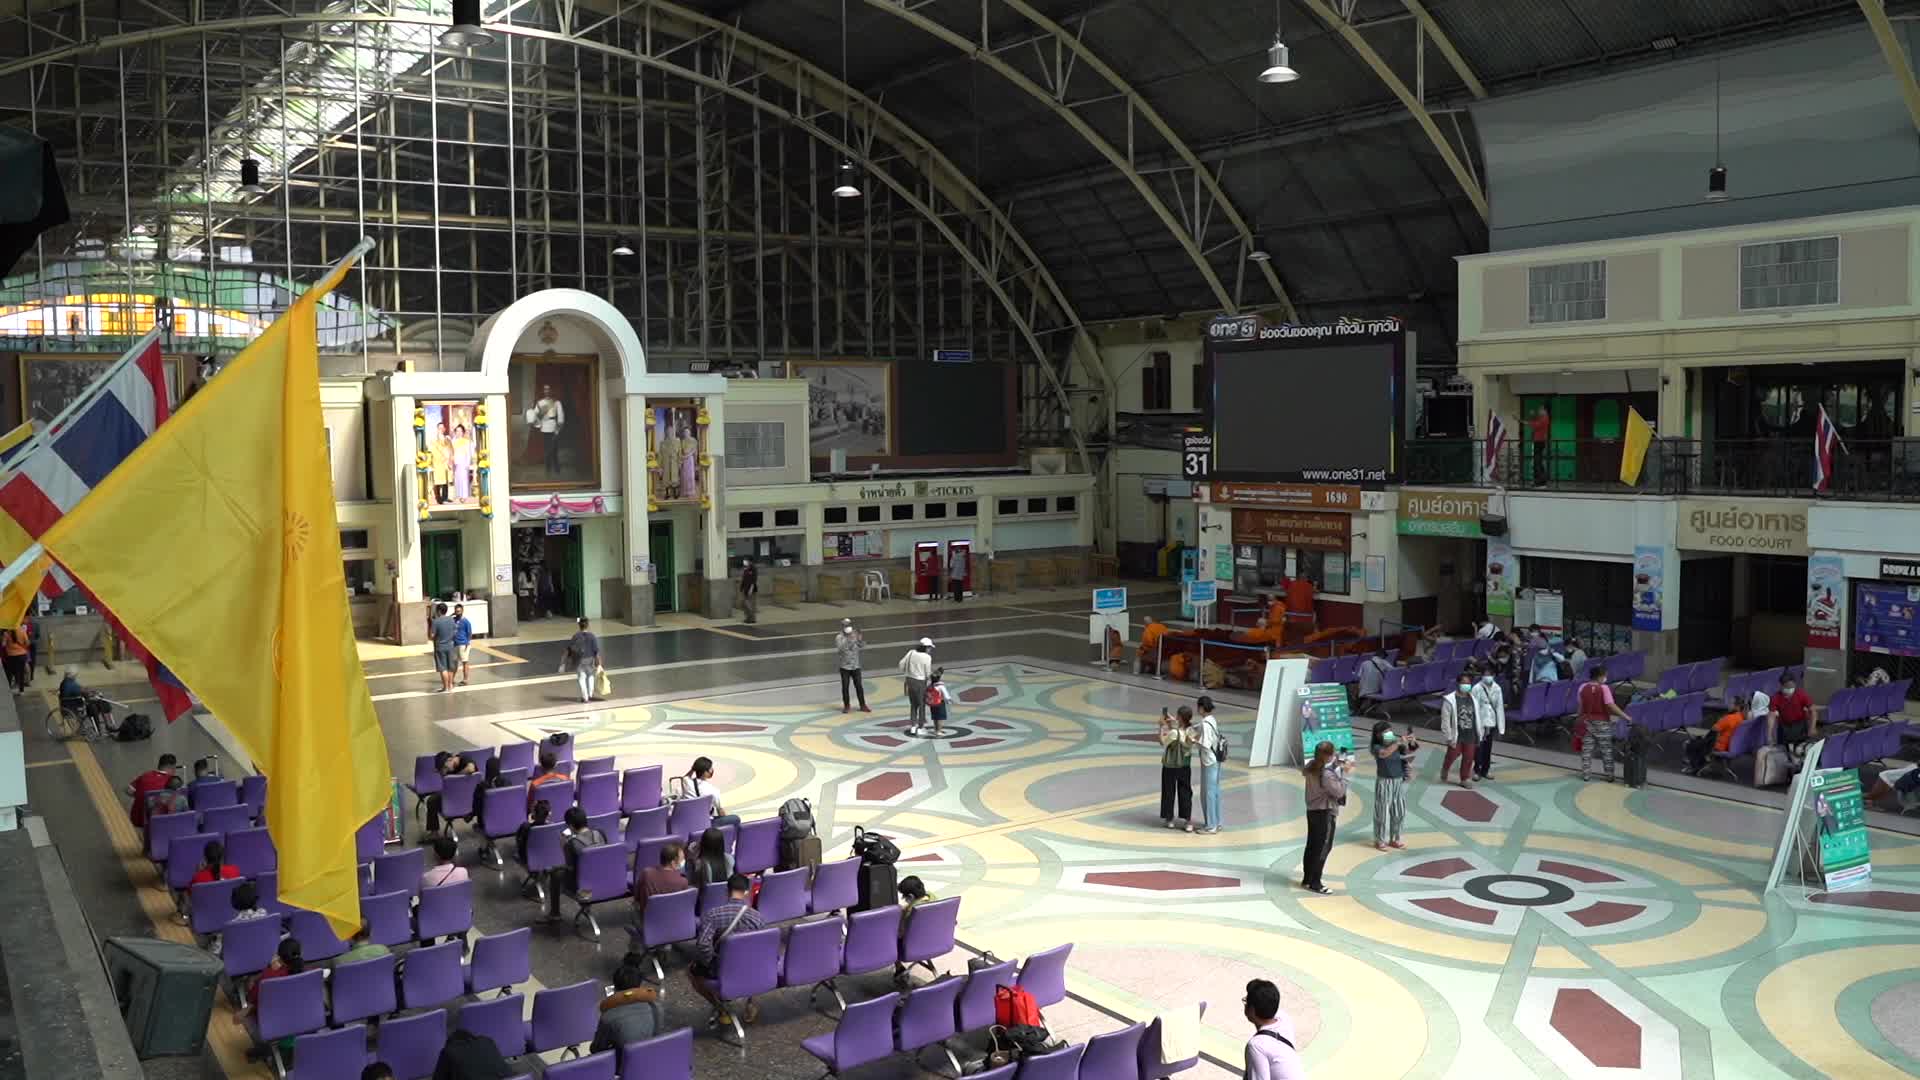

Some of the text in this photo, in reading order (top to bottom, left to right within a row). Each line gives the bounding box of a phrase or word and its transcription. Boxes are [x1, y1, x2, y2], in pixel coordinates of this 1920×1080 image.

[1369, 317, 1400, 336] ทุกวัน
[1185, 453, 1208, 475] 31
[1303, 469, 1386, 481] www.one31.net
[1690, 506, 1805, 534] ศูนย์อาหาร
[1710, 535, 1792, 549] FOOD COURT
